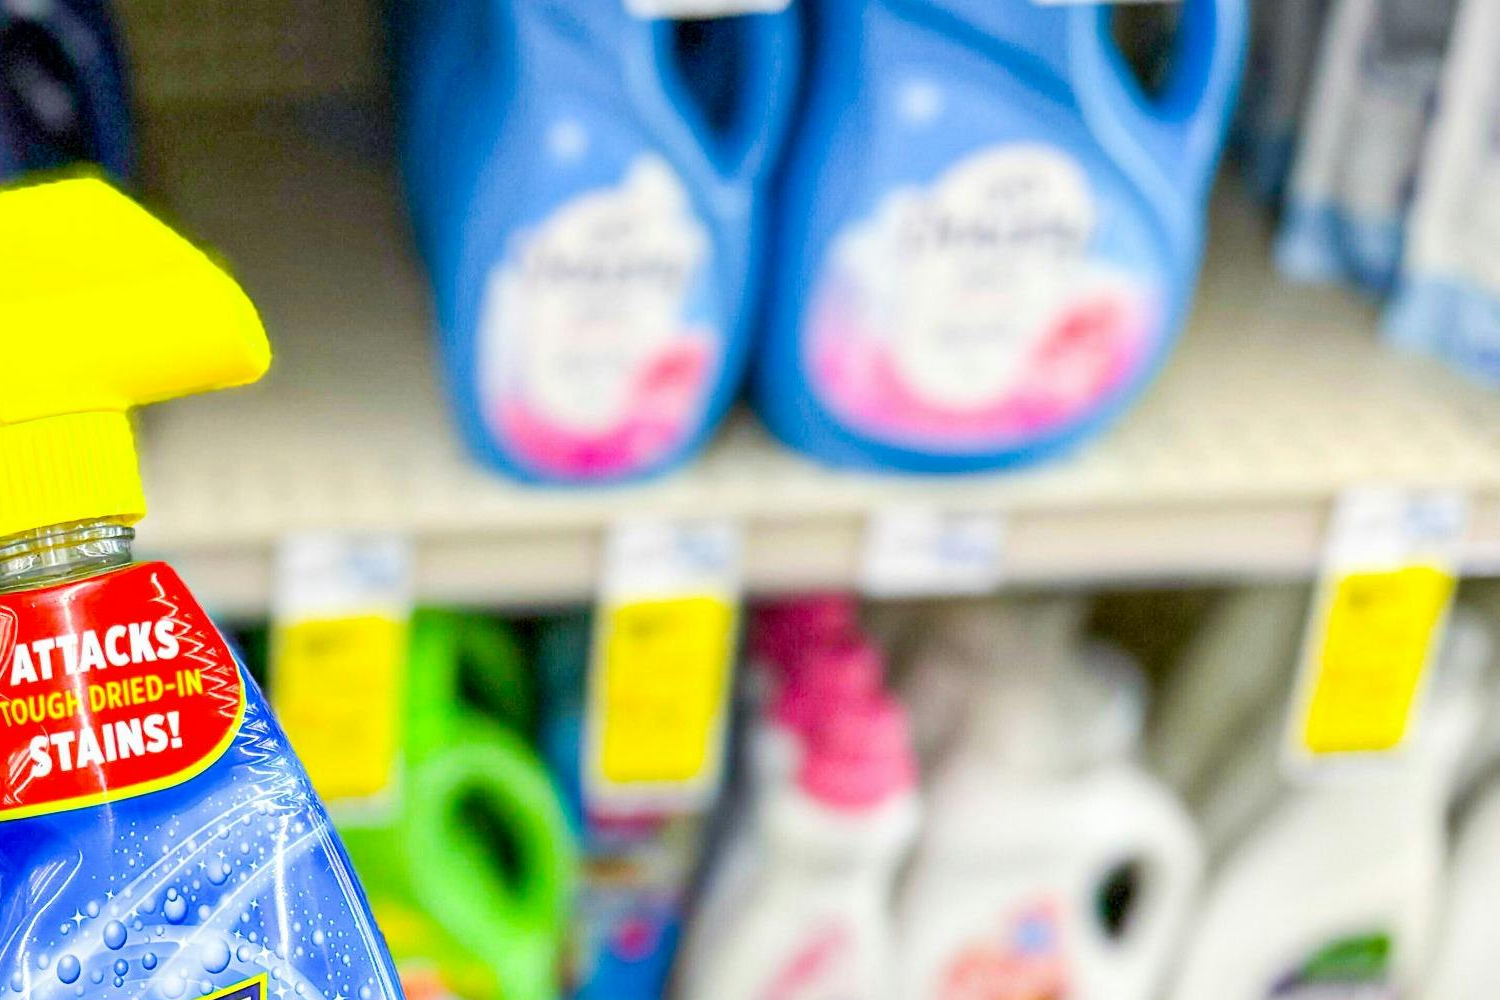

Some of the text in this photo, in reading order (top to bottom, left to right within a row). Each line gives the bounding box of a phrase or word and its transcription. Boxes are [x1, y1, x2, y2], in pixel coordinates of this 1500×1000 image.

[10, 620, 180, 686] ATTACKS
[89, 669, 204, 716] DRIED-IN
[30, 711, 183, 778] STAINS!
